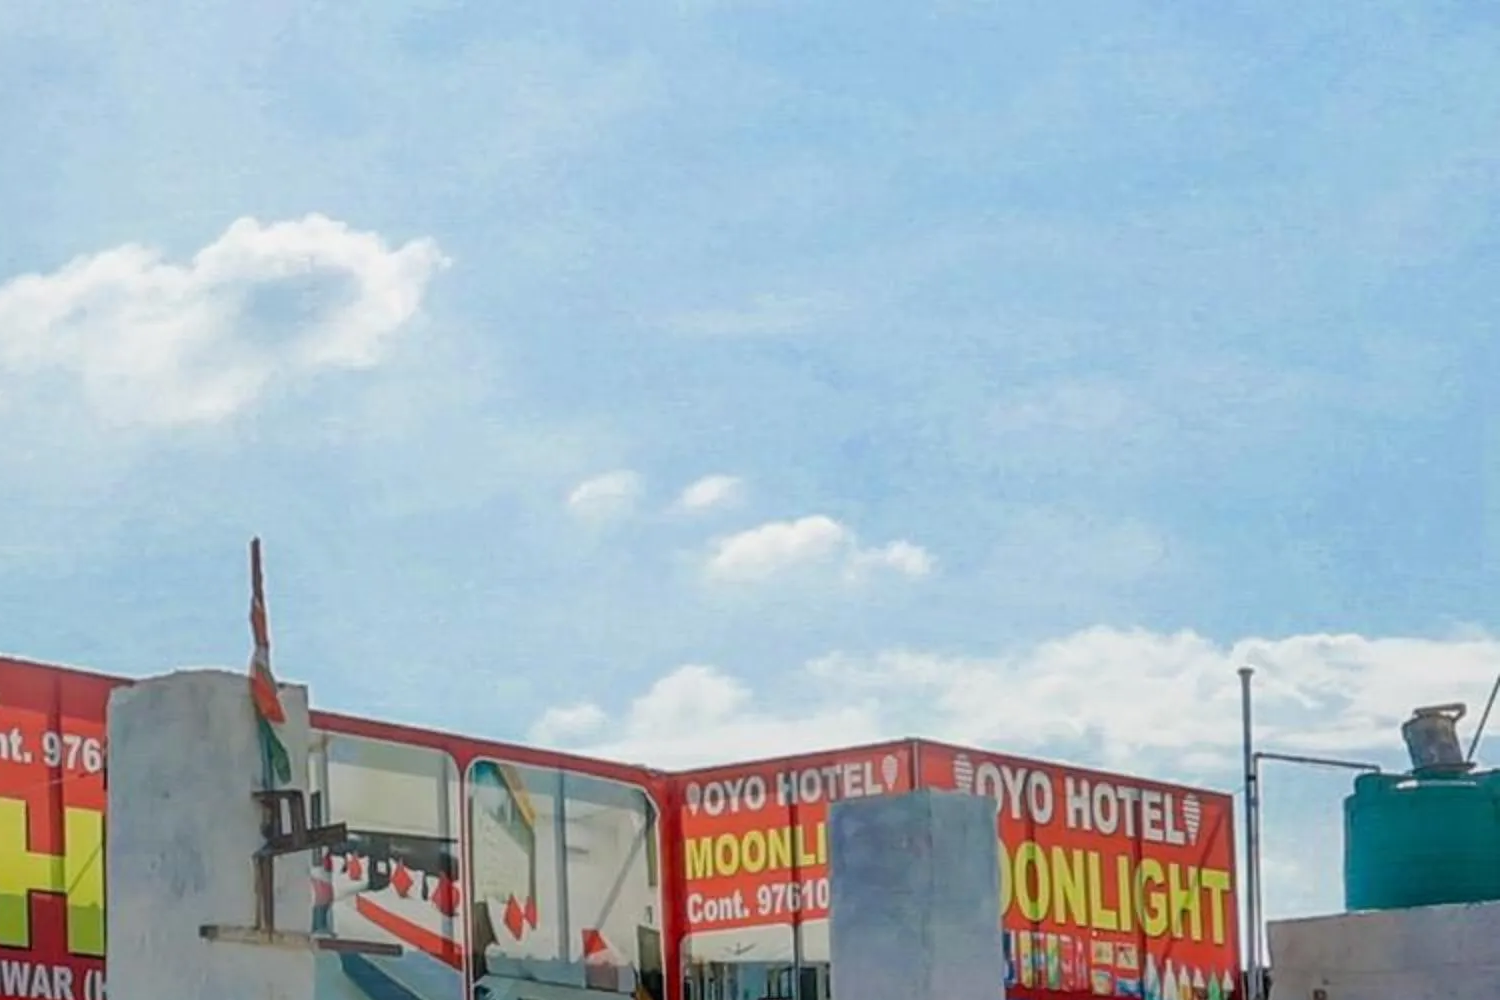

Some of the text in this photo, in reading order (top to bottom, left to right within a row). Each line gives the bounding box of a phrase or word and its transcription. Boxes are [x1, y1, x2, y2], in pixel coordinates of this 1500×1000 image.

[703, 761, 883, 816] OYO HOTEL
[976, 761, 1186, 845] OYO HOTEL
[685, 822, 828, 881] MOONLI
[687, 889, 750, 924] Cont.
